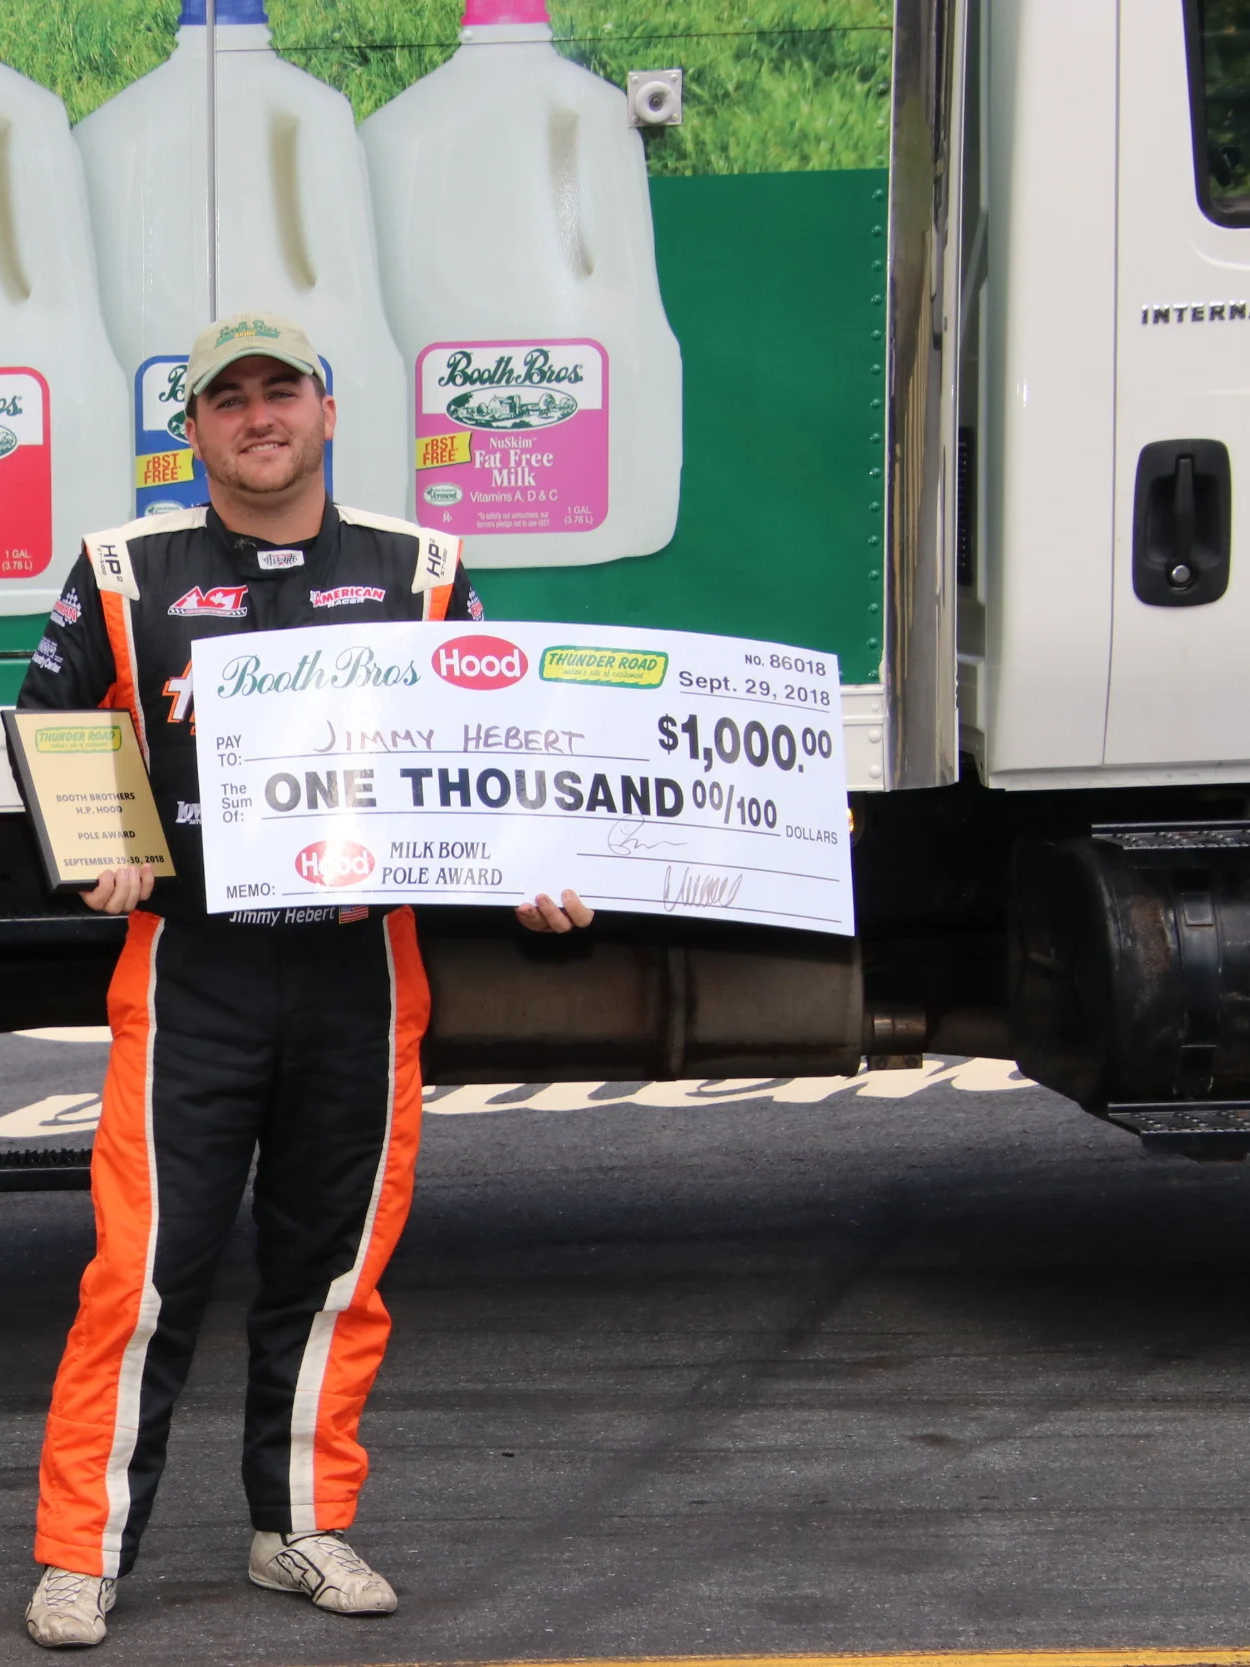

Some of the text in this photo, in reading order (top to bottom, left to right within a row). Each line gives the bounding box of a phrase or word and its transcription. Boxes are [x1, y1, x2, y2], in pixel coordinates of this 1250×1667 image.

[1141, 299, 1250, 325] INTERN
[438, 350, 515, 387] Booth
[425, 435, 457, 451] rBST
[489, 436, 533, 449] NuSkim
[146, 452, 180, 471] rBST
[473, 449, 554, 468] Fat Free
[490, 468, 537, 487] Milk
[469, 491, 512, 503] Vitamins
[527, 490, 536, 501] D
[538, 490, 547, 501] &
[548, 489, 558, 501] C
[1, 560, 33, 571] (3.78 L)
[313, 585, 386, 608] AMERICAN
[327, 598, 365, 609] RACER
[438, 648, 521, 678] Hood
[548, 652, 658, 672] THUNDER ROAD
[769, 653, 827, 677] 86018
[216, 649, 331, 699] Booth
[330, 646, 422, 689] Bros
[678, 671, 831, 707] Sept. 29, 2018
[39, 730, 116, 742] THUNDER ROAD
[215, 734, 243, 750] PAY
[313, 719, 586, 755] JIMMY HEBERT
[217, 753, 244, 767] TO:
[55, 792, 136, 803] BOOTH BROTHERS
[220, 782, 248, 797] The
[264, 767, 779, 830] ONE THOUSAND 00/100
[76, 805, 123, 815] H.P. HOOD
[221, 796, 253, 810] Sum
[222, 810, 245, 824] Of:
[77, 830, 136, 841] POLE AWARD
[784, 825, 839, 846] DOLLARS
[389, 840, 492, 860] MILK BOWL
[63, 855, 165, 867] SEPTEMBER 29-30, 2018
[381, 866, 504, 887] POLE AWARD
[225, 884, 276, 900] MEMO:
[229, 905, 336, 927] Jimmy Hebert
